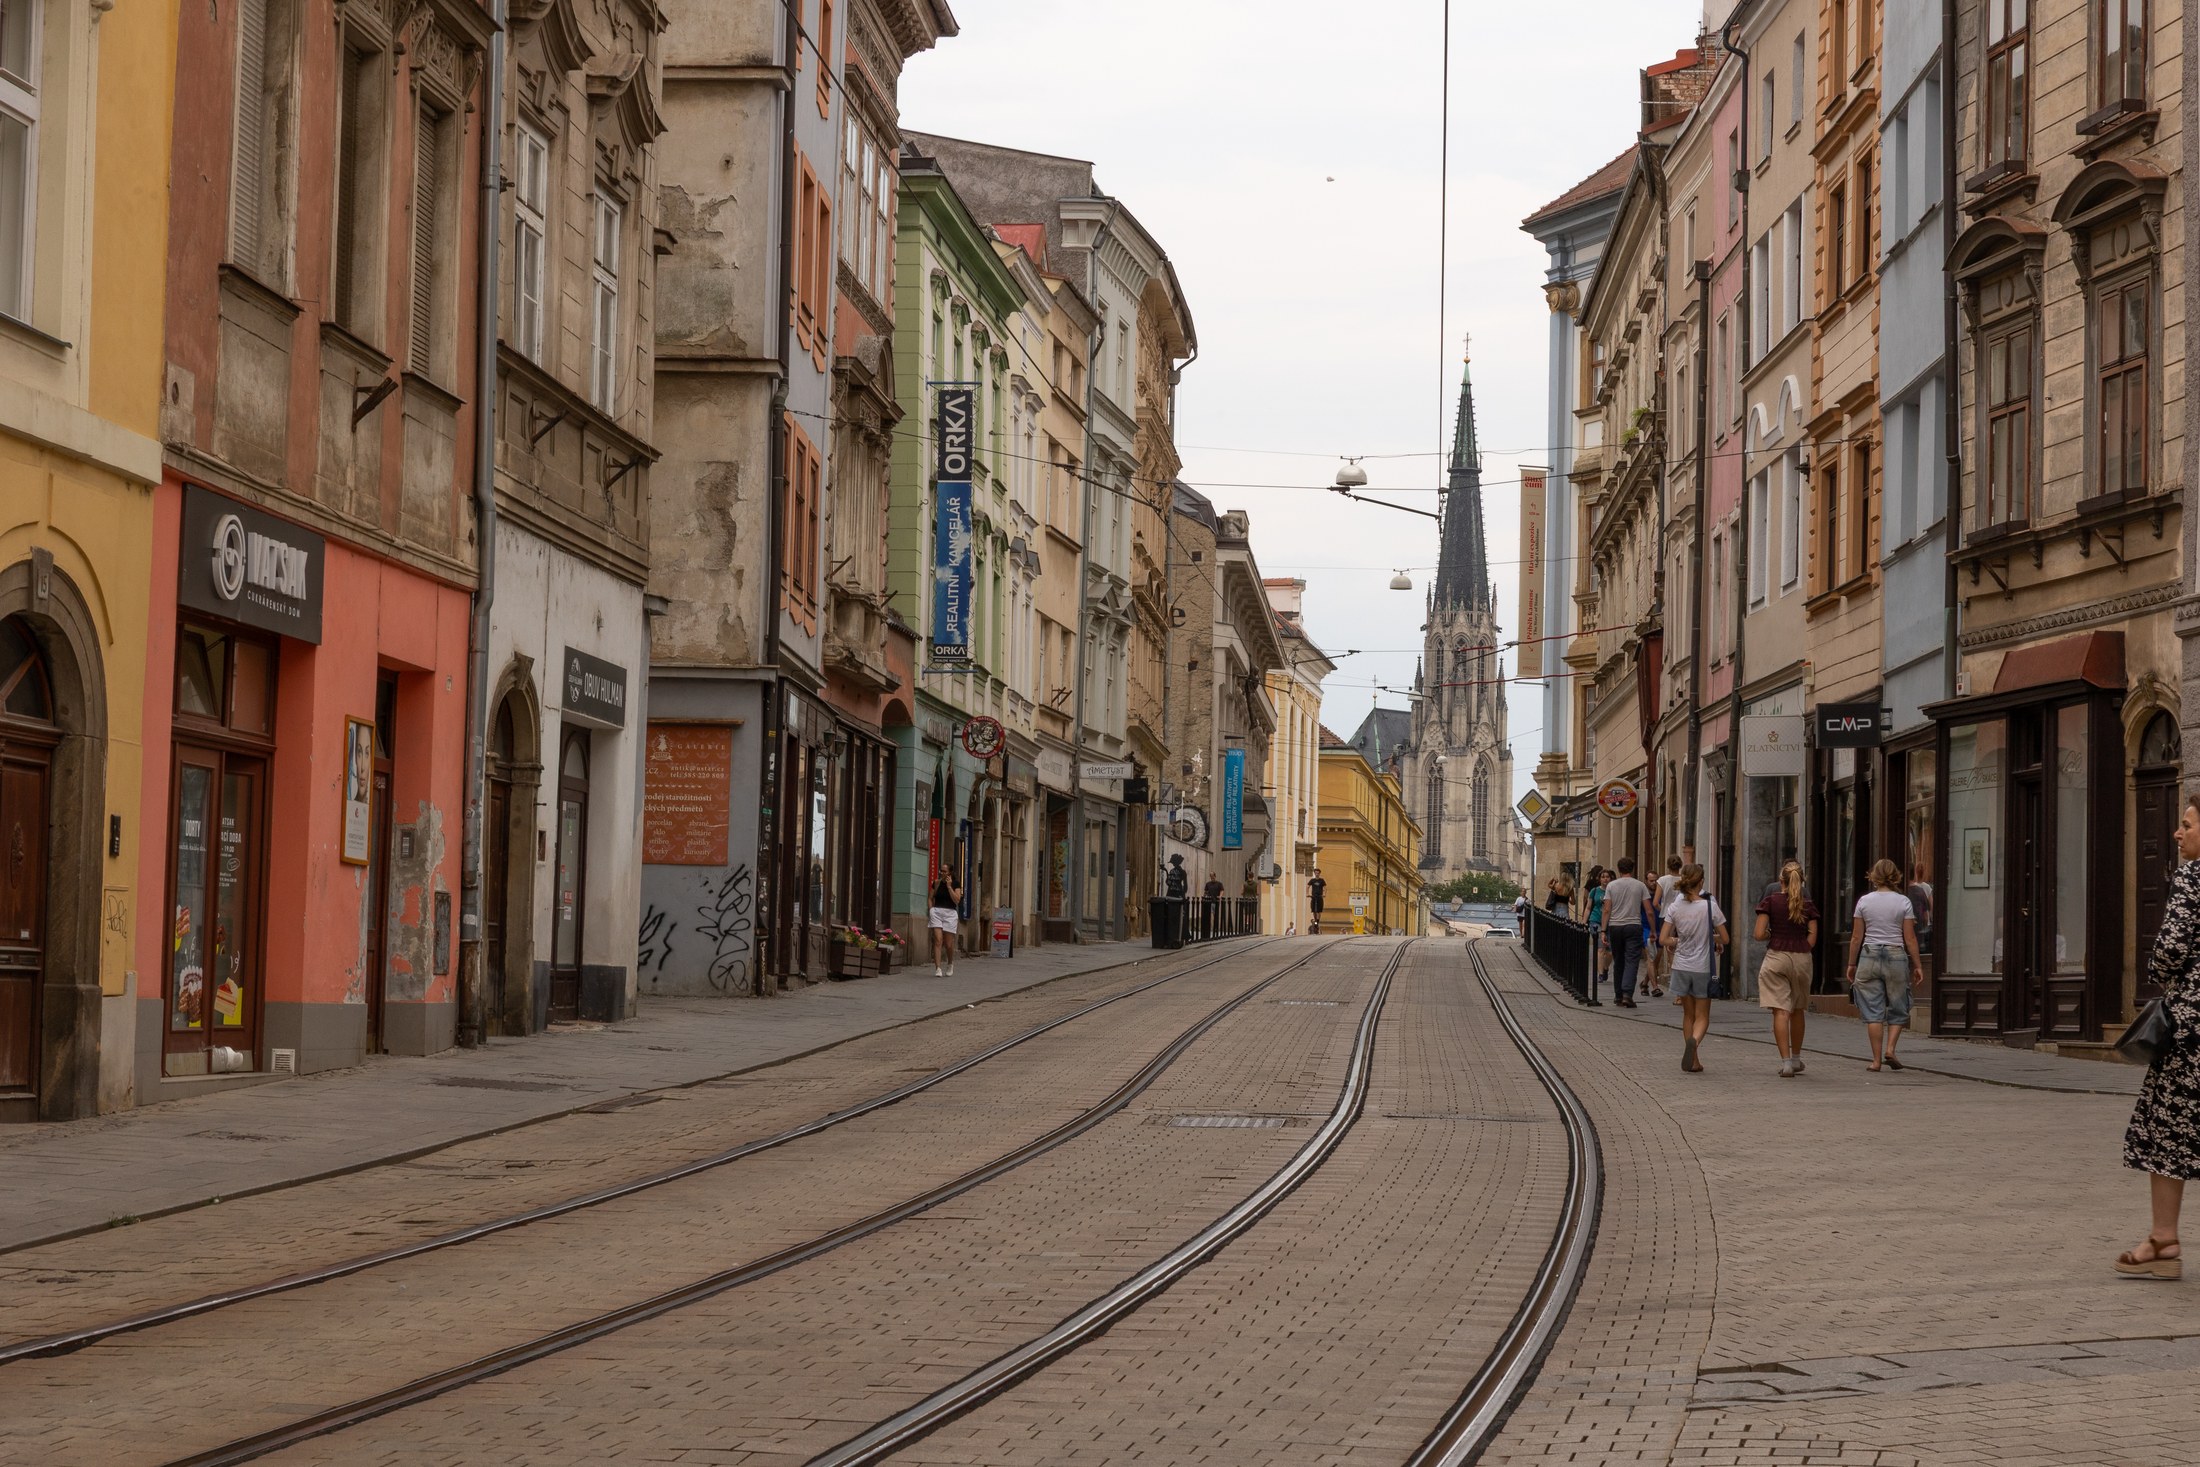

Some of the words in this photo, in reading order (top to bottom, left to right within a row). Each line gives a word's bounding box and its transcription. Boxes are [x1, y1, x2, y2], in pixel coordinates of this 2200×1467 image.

[945, 396, 966, 474] ORKA
[946, 497, 961, 566] KANCELÁŘ
[247, 532, 308, 600] VATSAK
[936, 646, 966, 655] ORKA
[584, 672, 600, 700] OBUV
[600, 677, 624, 708] HULMAN
[1826, 716, 1872, 732] CMP
[644, 793, 664, 802] rodej
[644, 804, 666, 813] ckých
